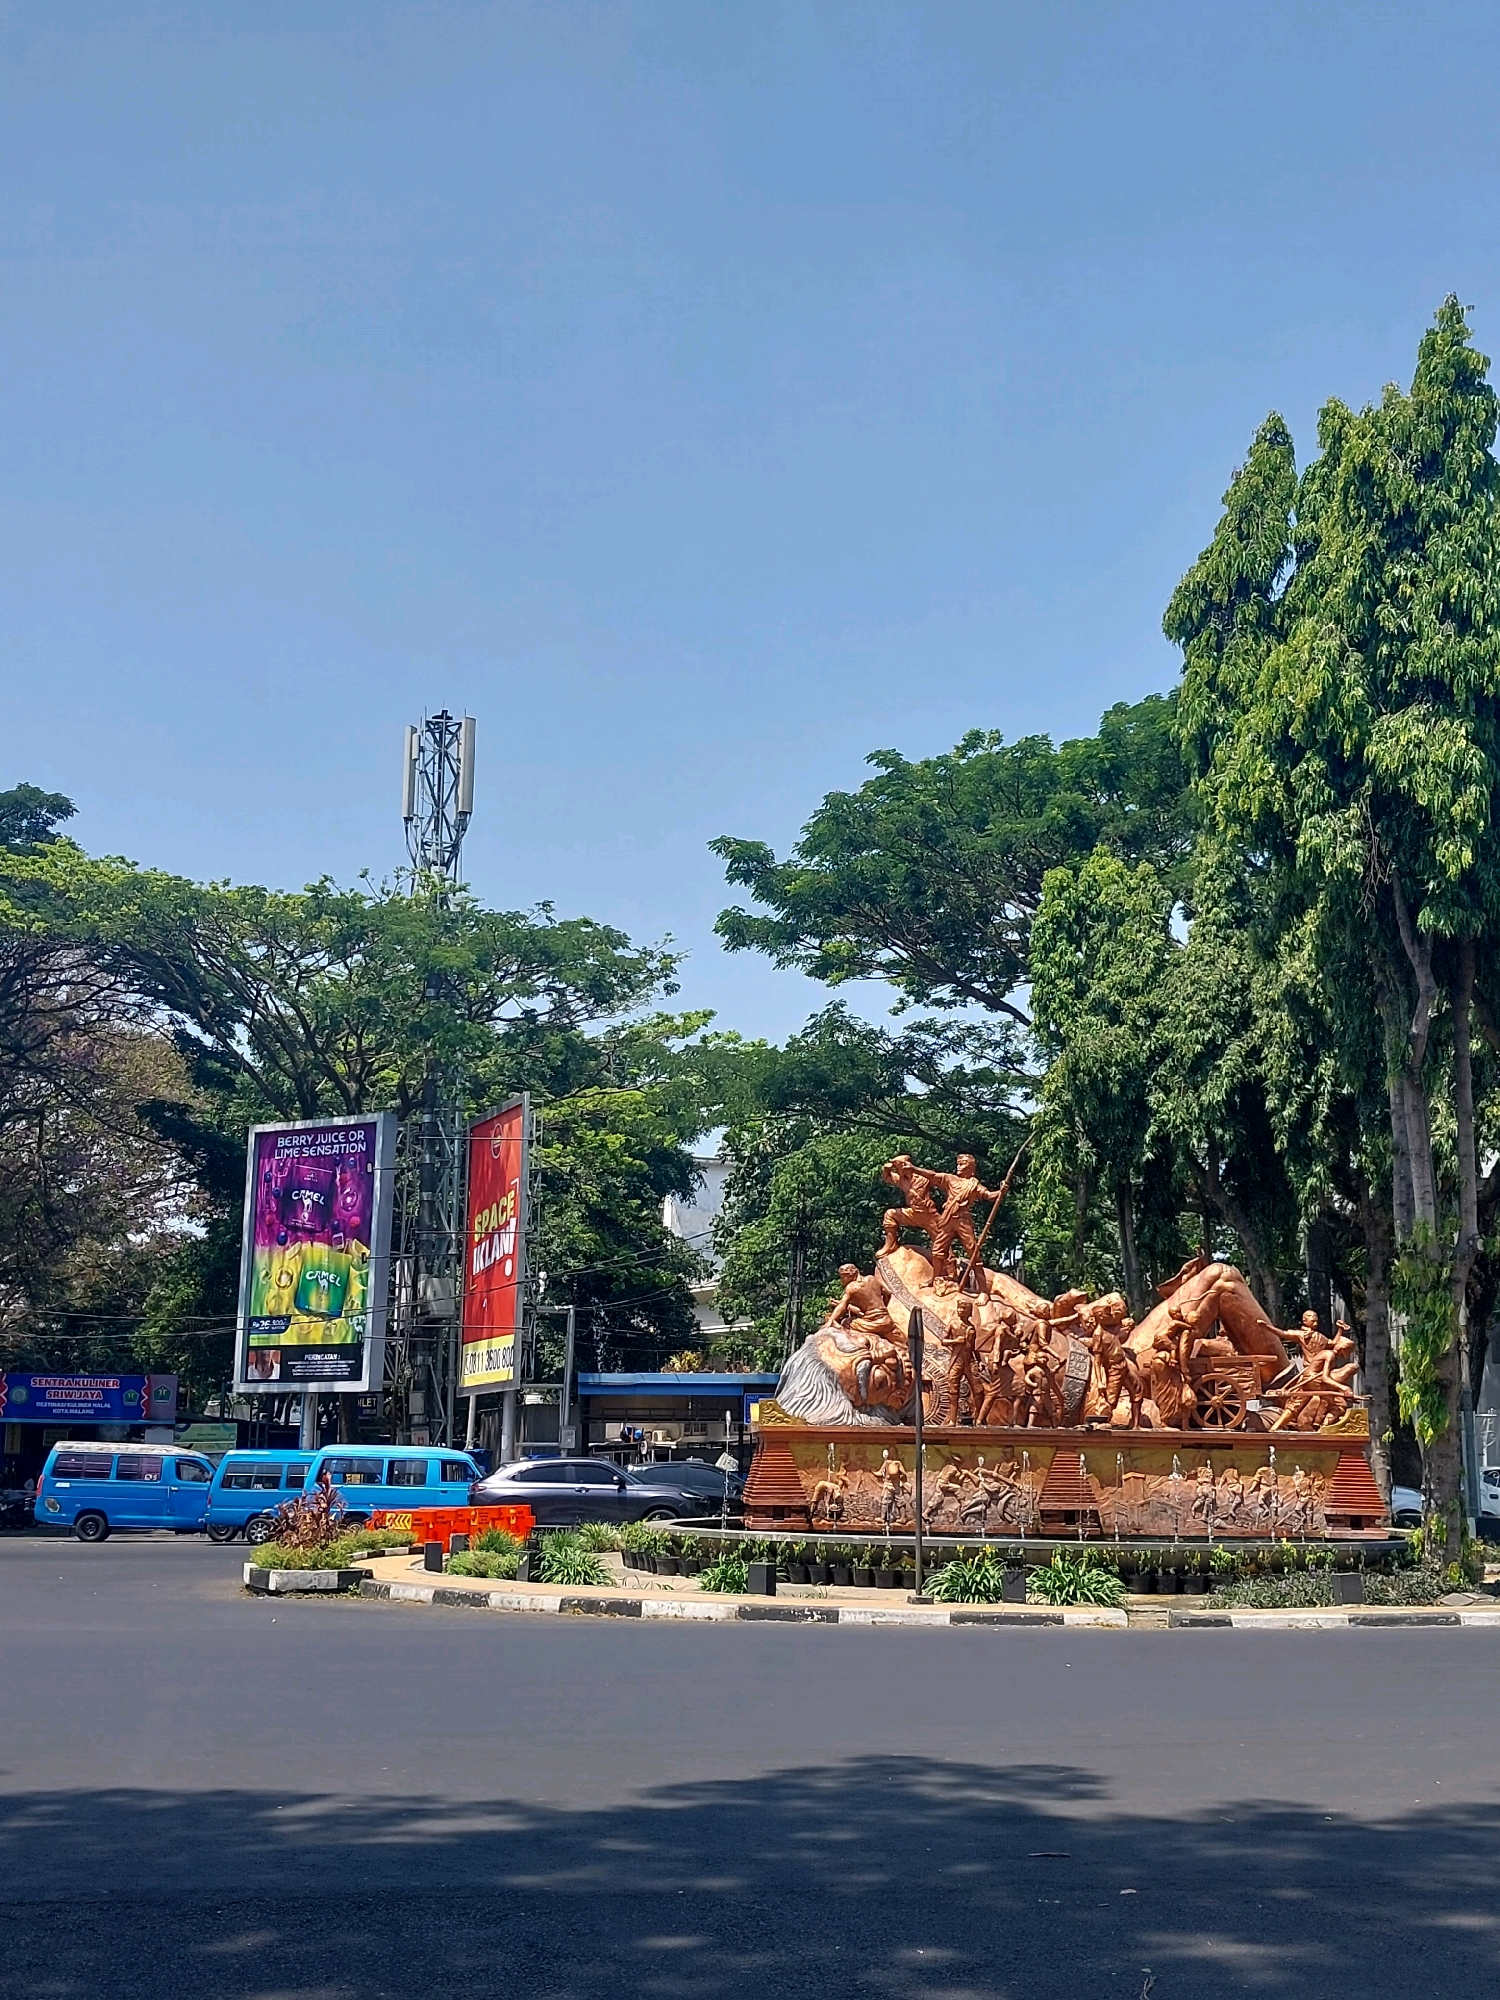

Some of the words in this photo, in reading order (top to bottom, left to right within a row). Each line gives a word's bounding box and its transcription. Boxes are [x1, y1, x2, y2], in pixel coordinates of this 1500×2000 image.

[277, 1134, 314, 1148] BERRY
[315, 1132, 346, 1144] JUICE
[348, 1130, 365, 1141] OR
[274, 1147, 300, 1160] LIME
[301, 1141, 367, 1157] SENSATION
[291, 1189, 325, 1205] CAMEL
[474, 1189, 515, 1243] SPACE
[305, 1270, 341, 1287] CAMEL
[31, 1377, 74, 1388] SENTRA
[74, 1378, 120, 1389] KULINER
[46, 1389, 103, 1400] SRIWIJAYA
